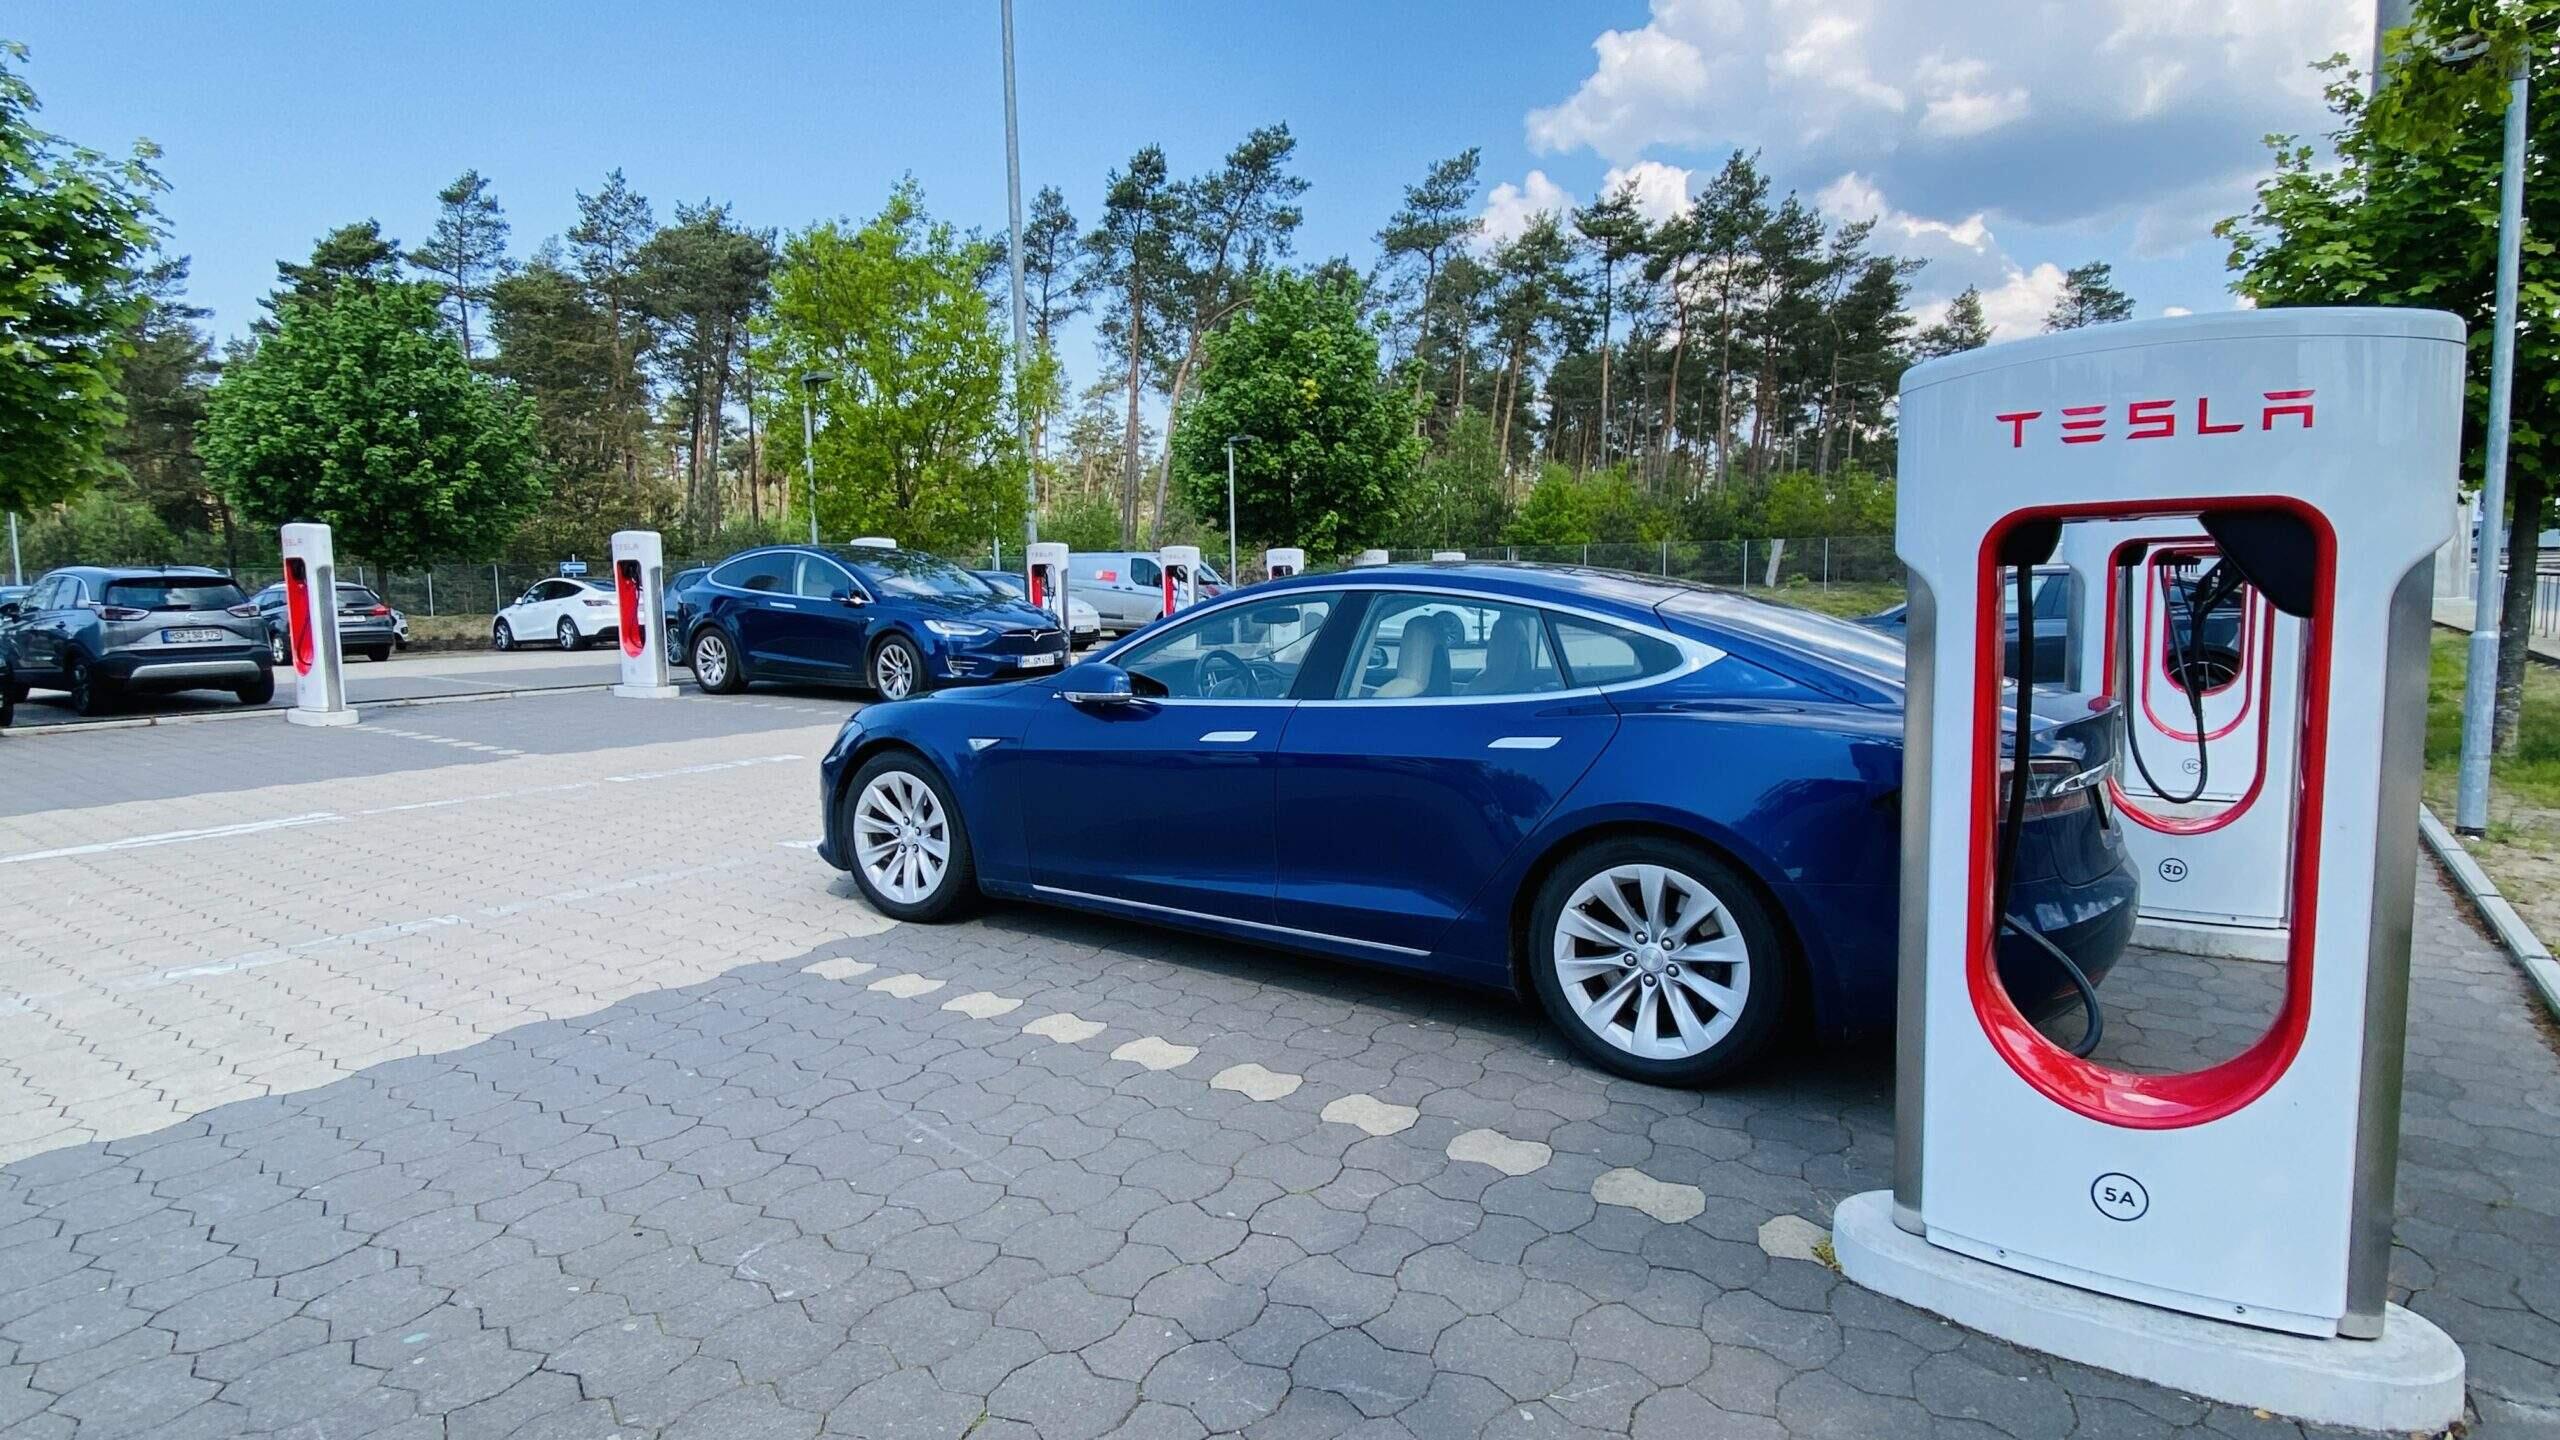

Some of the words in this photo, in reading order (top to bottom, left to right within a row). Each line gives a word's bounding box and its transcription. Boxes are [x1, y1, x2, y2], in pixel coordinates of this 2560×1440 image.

[1995, 390, 2316, 448] TESLA
[2186, 762, 2199, 770] 3C
[2163, 863, 2184, 875] 3D
[2104, 1187, 2136, 1207] 5A
